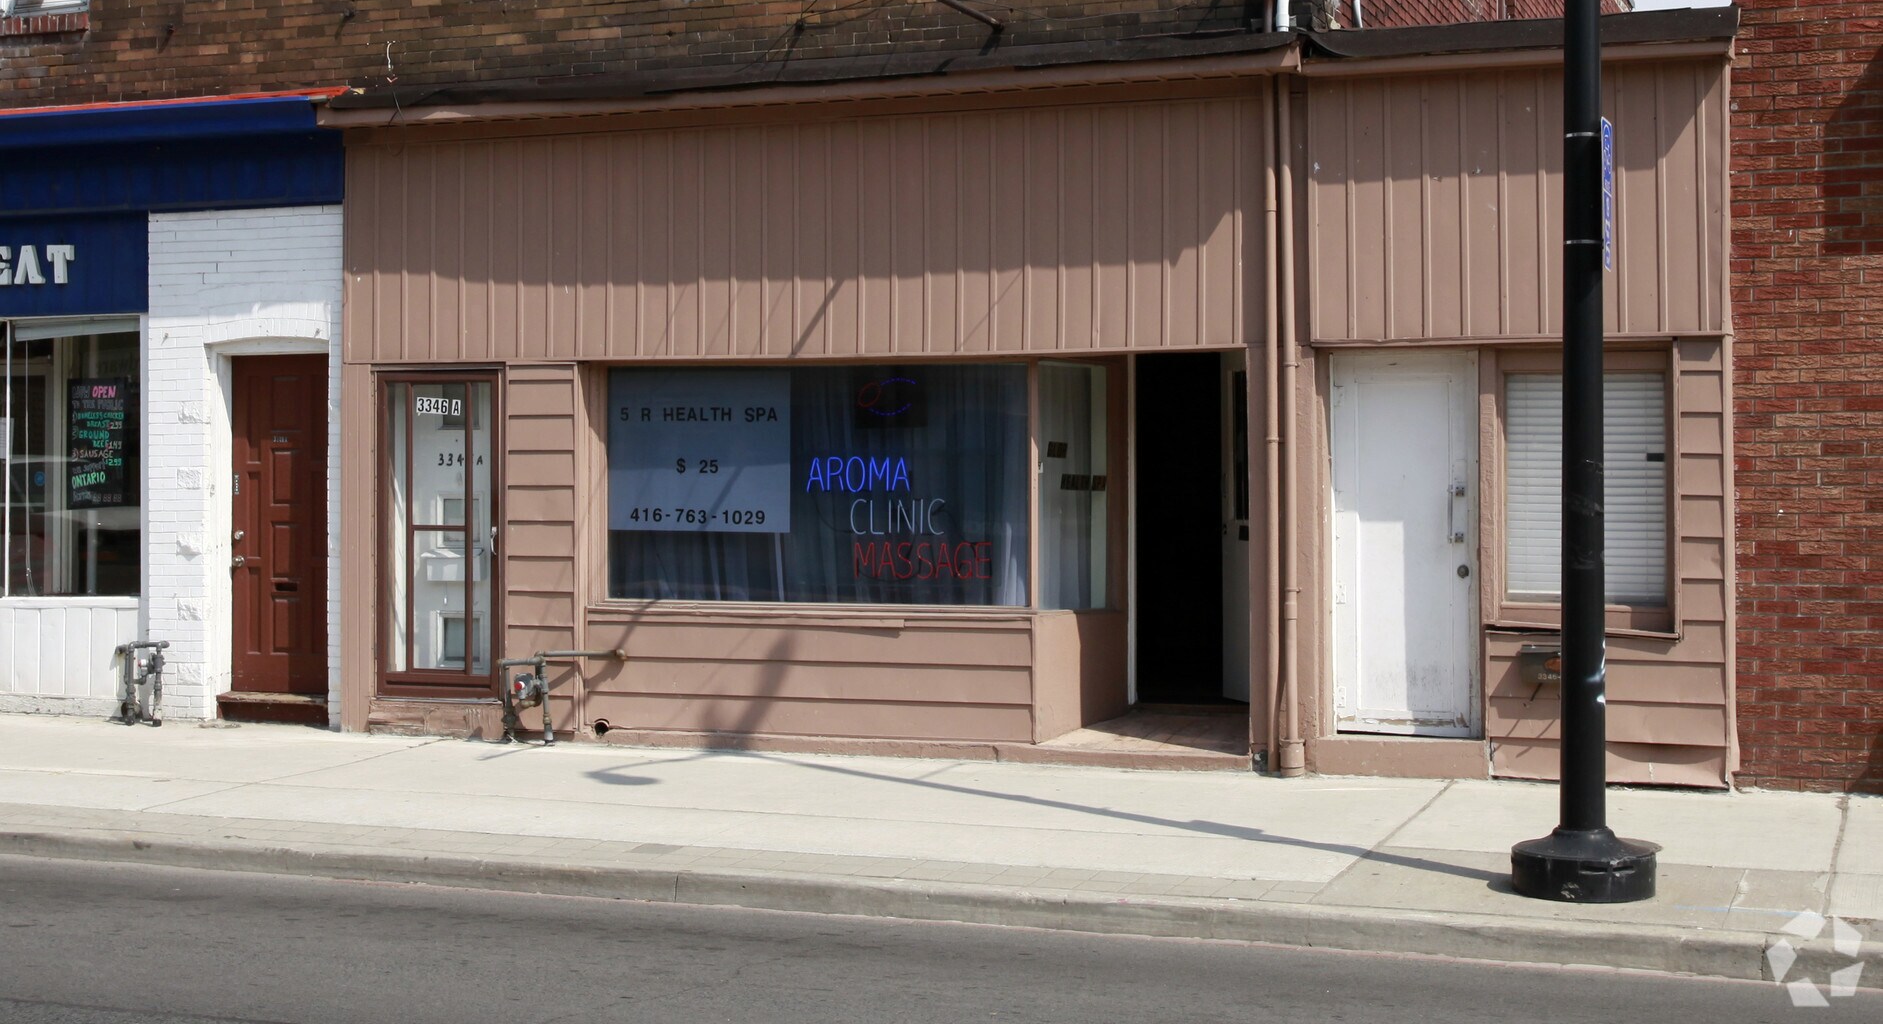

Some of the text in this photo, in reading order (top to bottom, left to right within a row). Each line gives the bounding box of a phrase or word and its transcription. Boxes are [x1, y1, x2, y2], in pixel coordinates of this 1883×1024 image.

[92, 385, 116, 398] OPEN
[418, 398, 460, 414] 3346 A
[620, 407, 778, 422] 5 R HEALTH SPA
[79, 430, 109, 439] GROUND
[79, 449, 113, 458] SAUSAGE
[676, 457, 719, 474] $ 25
[72, 471, 106, 489] ONTARIO
[806, 456, 911, 493] AROMA
[630, 508, 766, 524] 416-763-1029
[850, 498, 946, 536] CLINIC
[854, 541, 993, 580] MASSAGE
